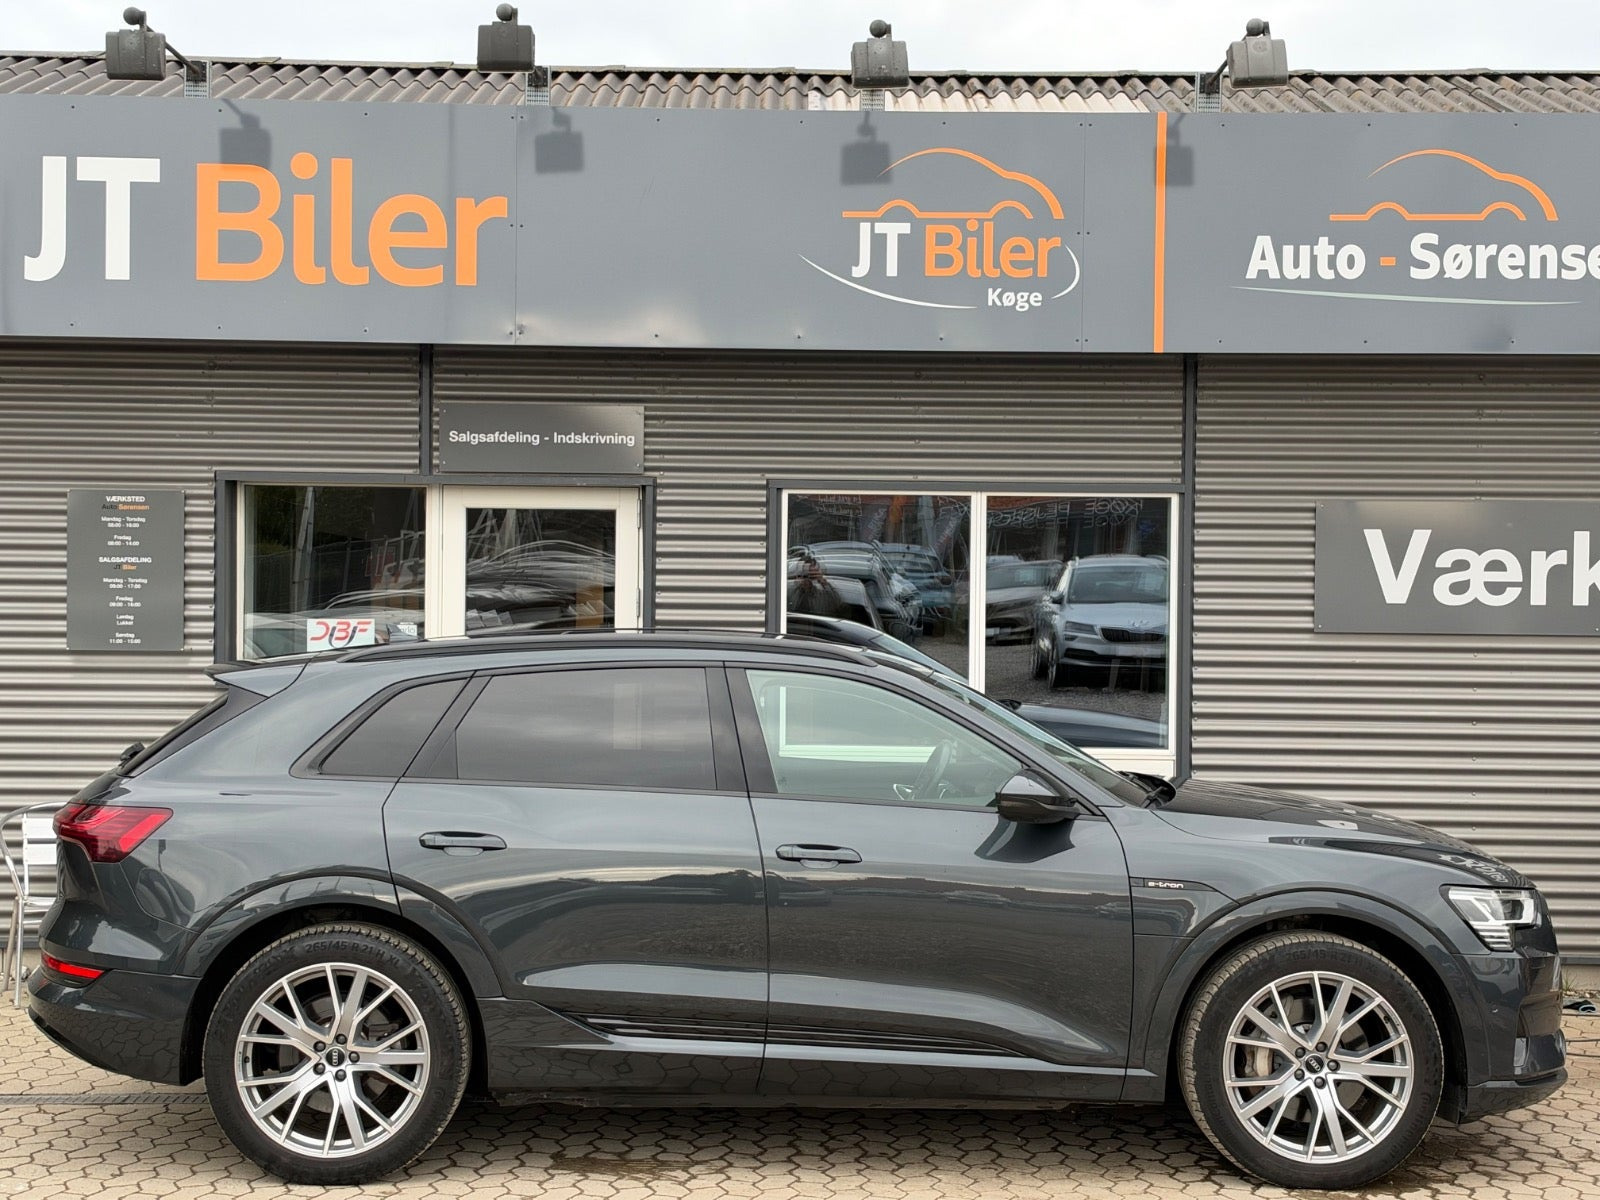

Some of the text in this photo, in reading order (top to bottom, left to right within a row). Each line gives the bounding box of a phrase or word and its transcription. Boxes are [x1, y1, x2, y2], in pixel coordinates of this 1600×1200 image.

[24, 152, 508, 287] JT Biler
[851, 218, 1062, 278] JT Biler
[1245, 235, 1366, 280] Auto
[987, 287, 1043, 312] Køge
[449, 430, 540, 446] Salgsafdeling
[553, 431, 636, 447] Indskrivning
[1363, 528, 1600, 607] Værk
[1147, 880, 1184, 889] e-tron
[305, 940, 348, 954] 265/45
